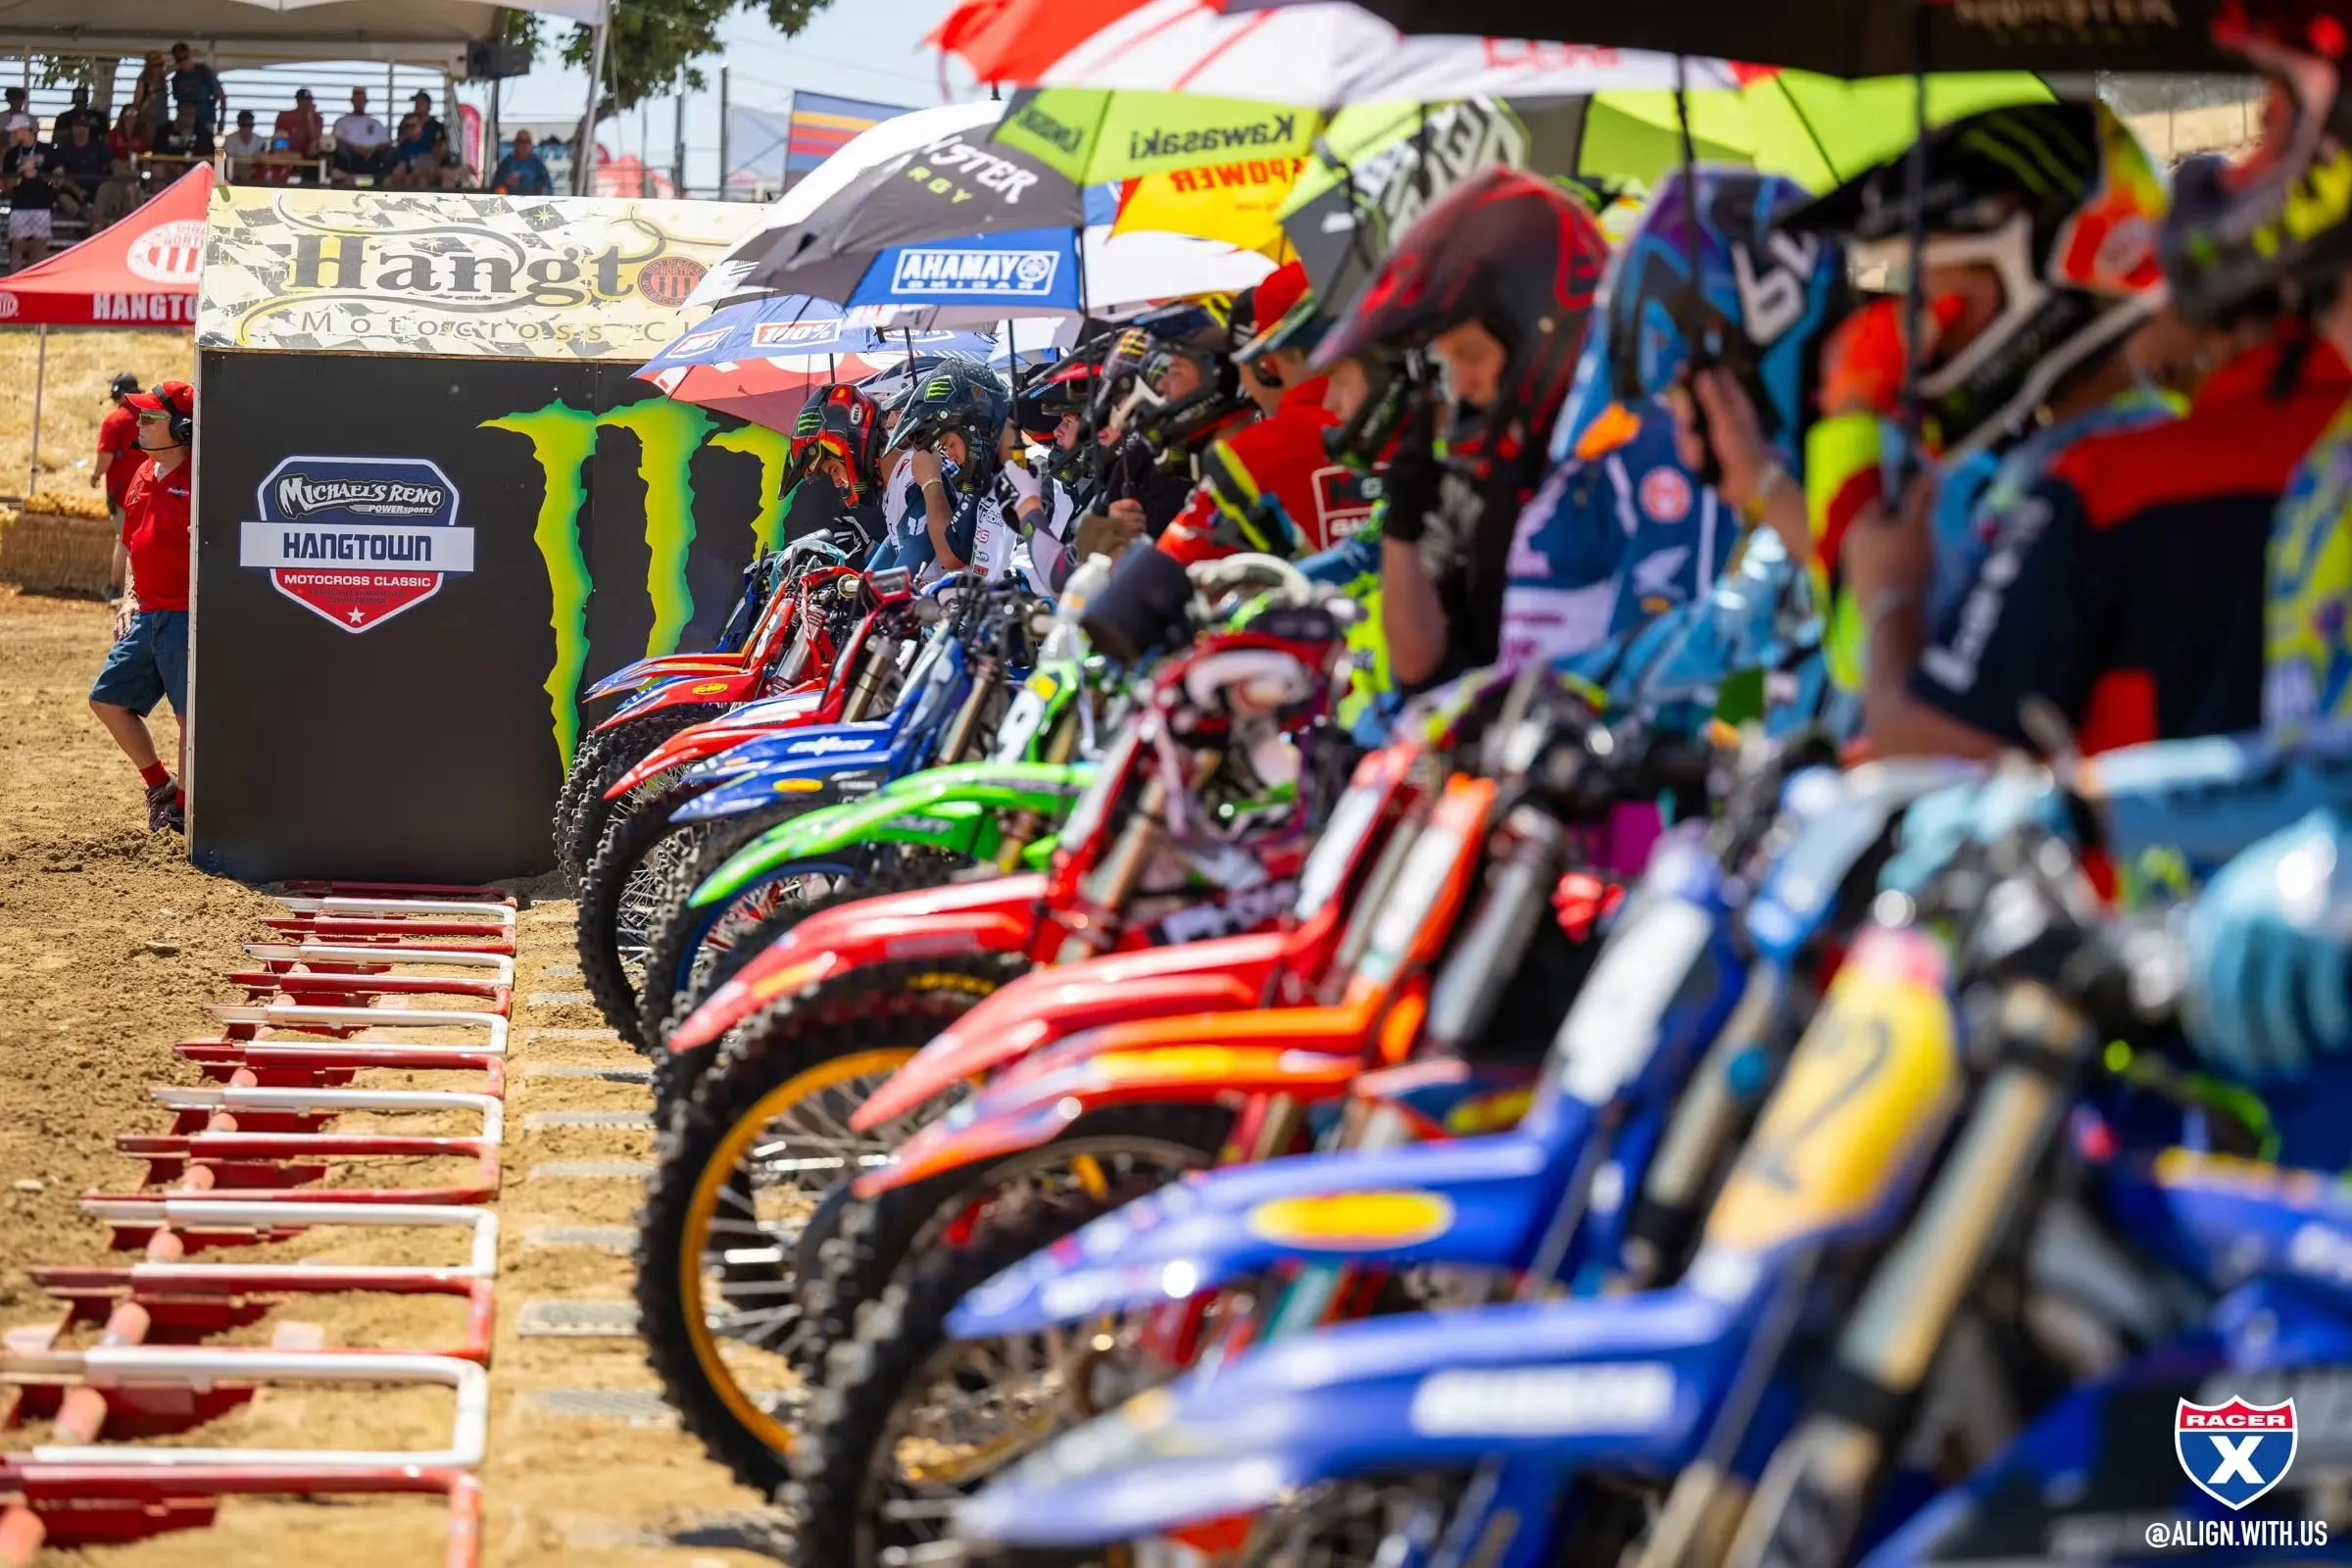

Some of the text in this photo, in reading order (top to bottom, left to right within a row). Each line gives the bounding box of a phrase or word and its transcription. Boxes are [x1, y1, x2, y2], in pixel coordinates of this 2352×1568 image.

[92, 294, 198, 320] HANGTO
[301, 311, 604, 343] Motocross
[279, 477, 442, 515] MICHAEL'S RENO
[283, 532, 432, 562] HANGTOWN
[284, 574, 431, 588] MOTOCROSS CLASSIC
